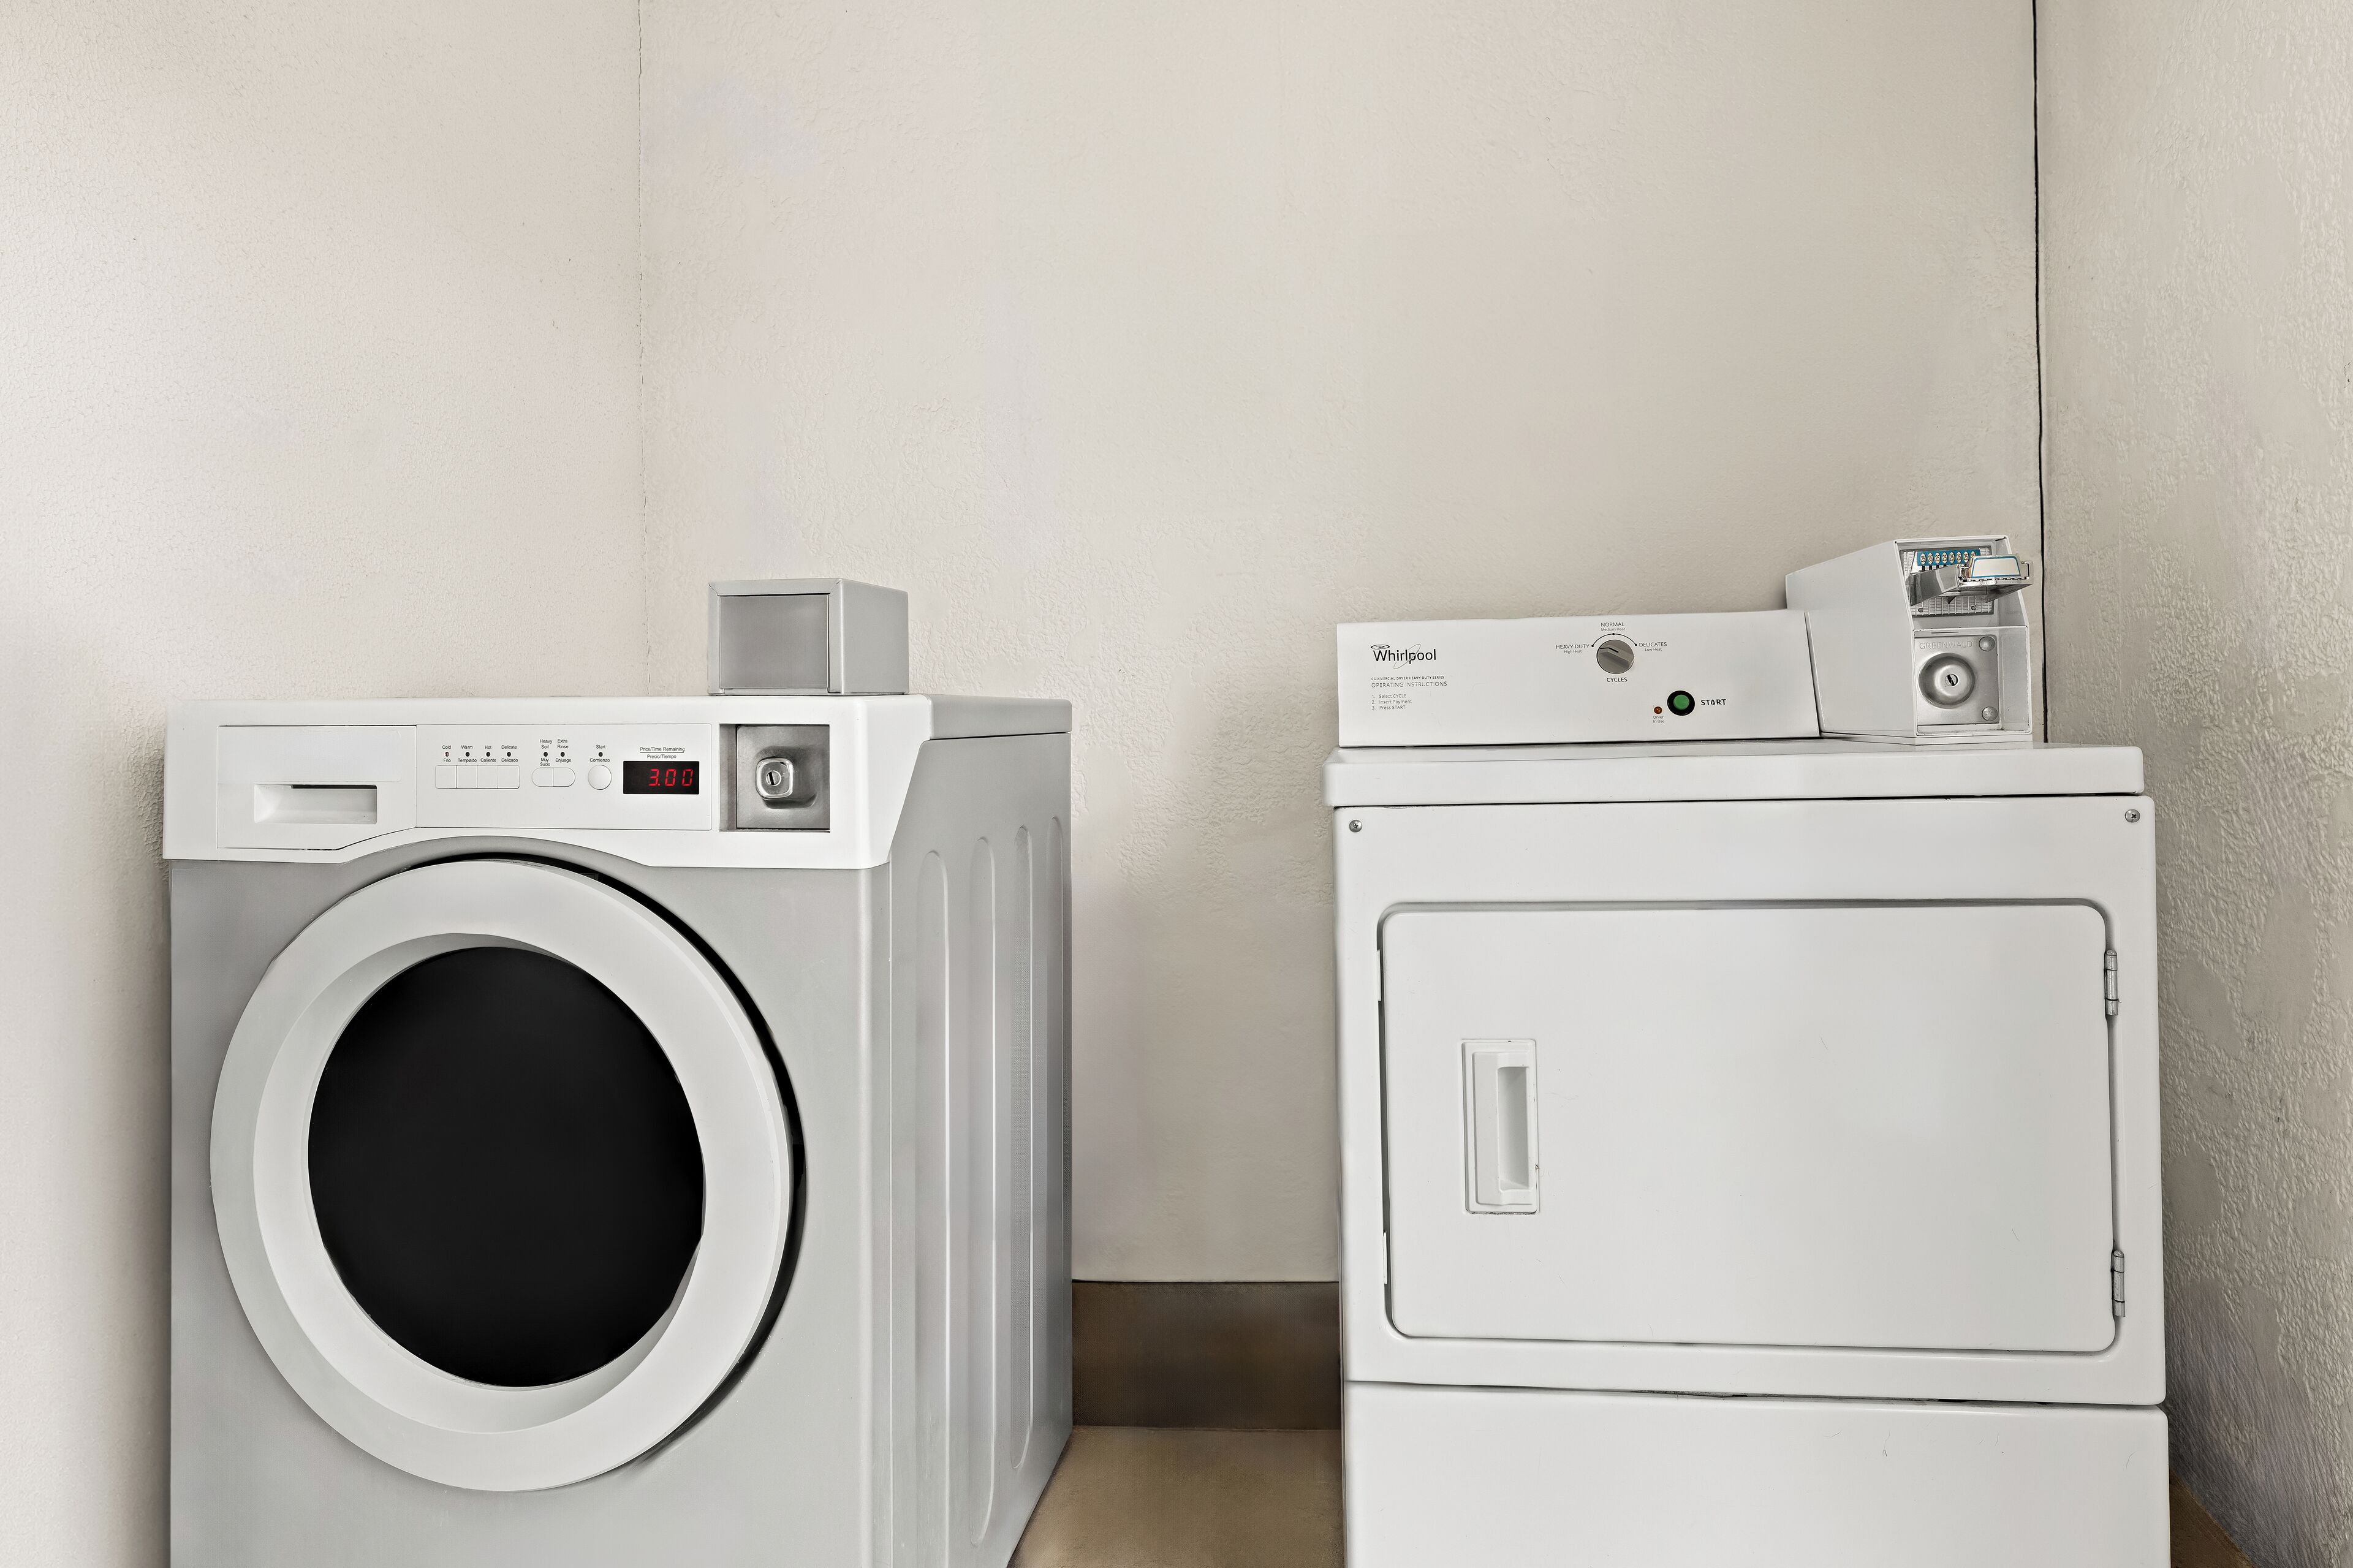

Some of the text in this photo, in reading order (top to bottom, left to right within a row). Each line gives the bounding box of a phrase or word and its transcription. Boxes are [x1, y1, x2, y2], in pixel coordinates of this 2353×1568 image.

[1920, 641, 1972, 650] GREENWALD
[1373, 649, 1436, 664] Whirlpool
[648, 769, 694, 786] 3.00
